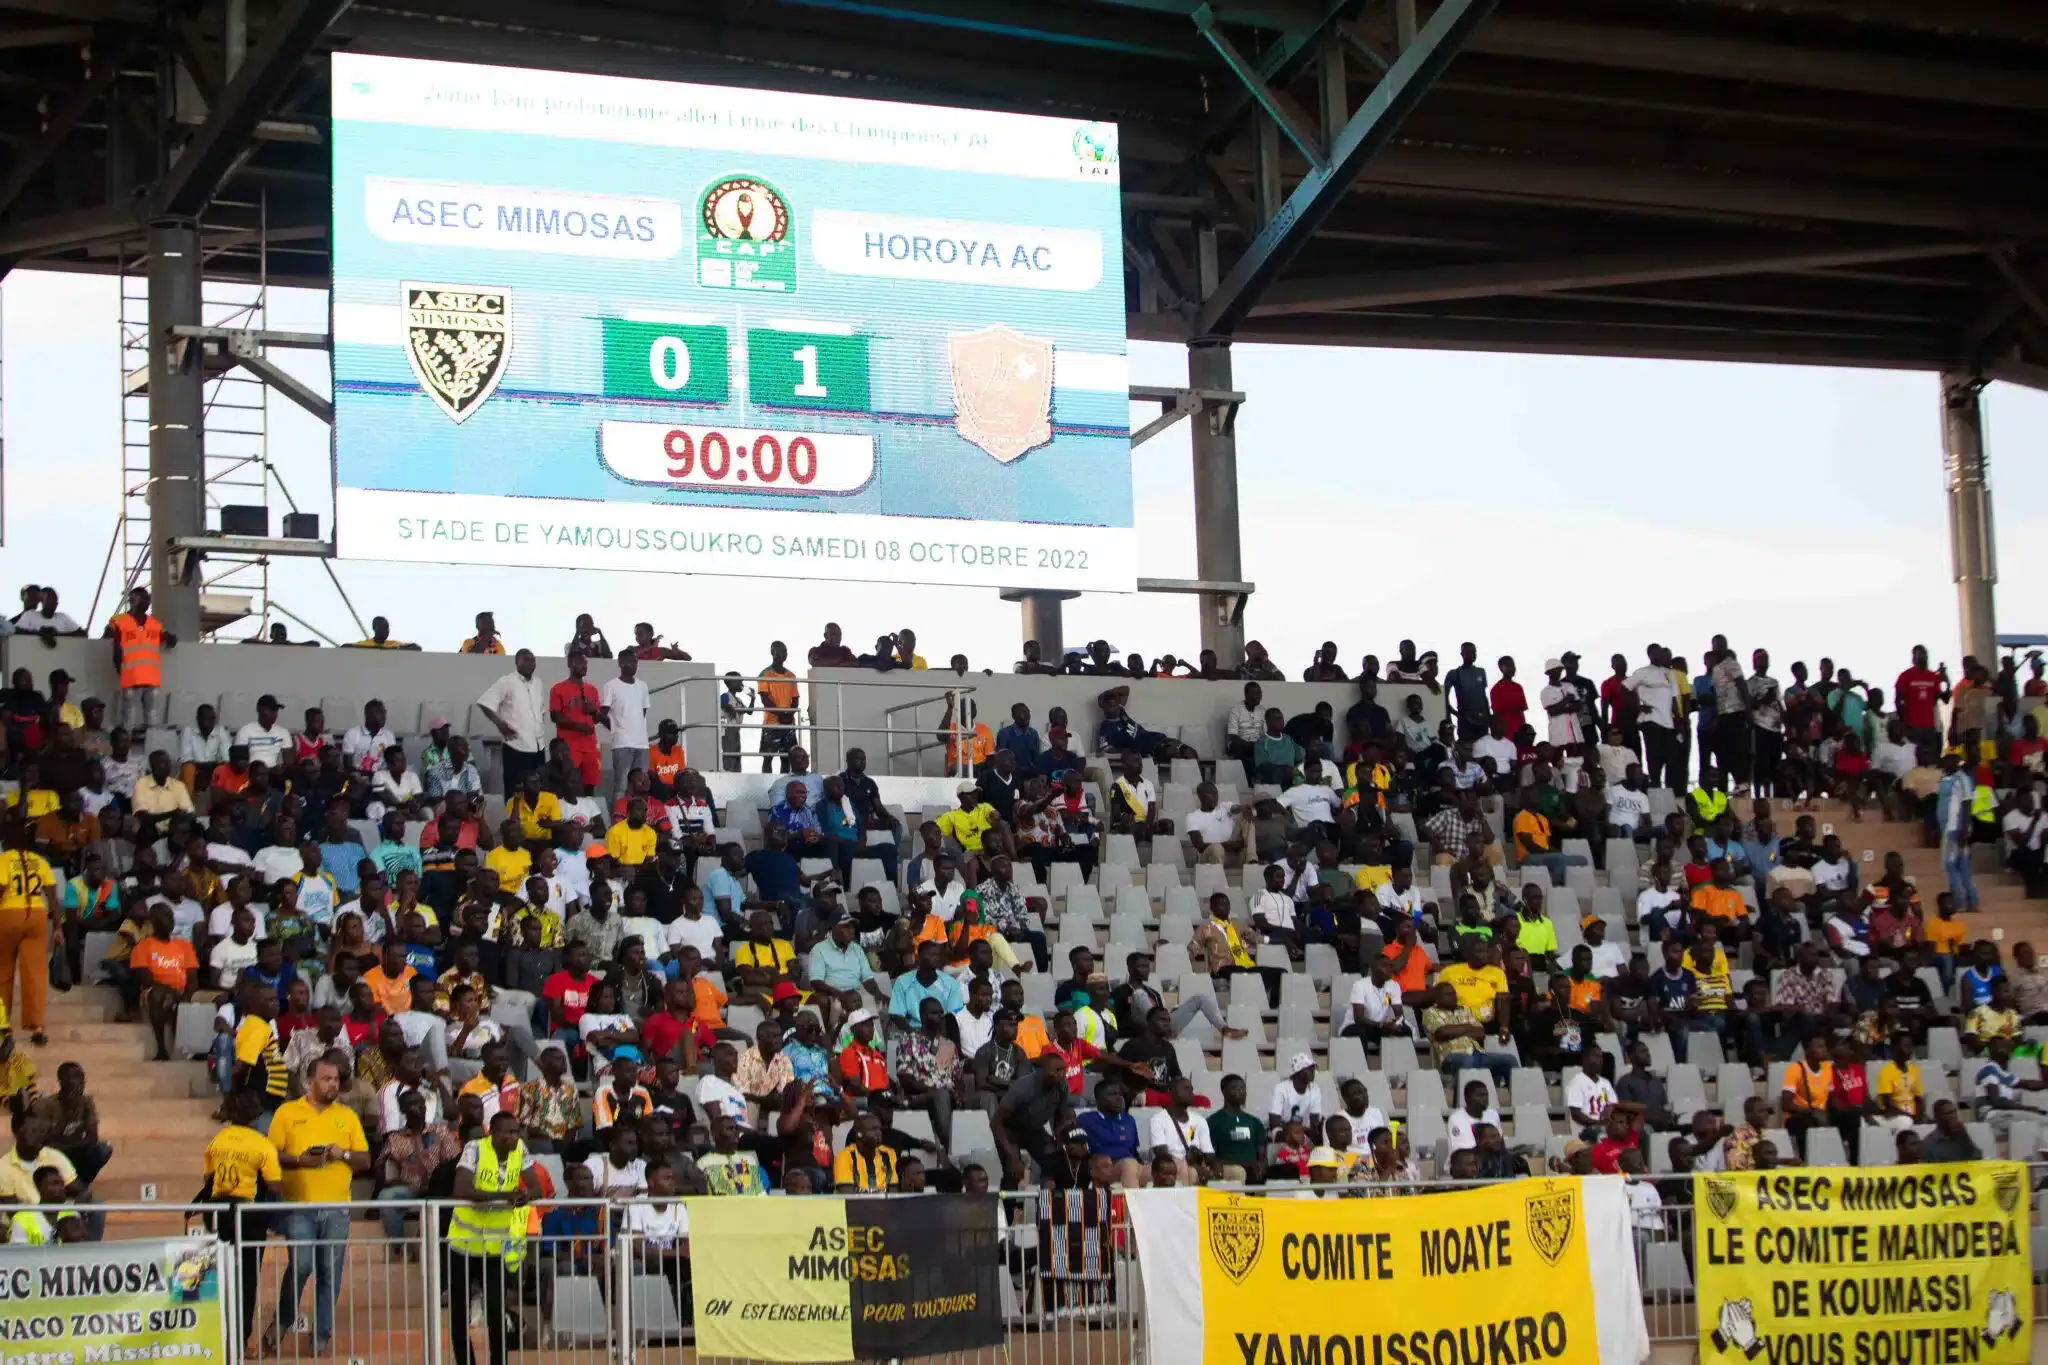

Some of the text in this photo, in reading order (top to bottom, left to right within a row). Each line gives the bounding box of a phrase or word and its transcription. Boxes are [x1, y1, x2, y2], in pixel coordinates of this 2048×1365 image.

[392, 198, 656, 242] ASEC MIMOSAS
[864, 231, 1053, 271] HOROYA AC
[410, 290, 503, 314] ASEC
[649, 336, 690, 391] 0
[793, 345, 827, 397] 1
[663, 429, 817, 485] 90:00
[398, 518, 1089, 570] STADE DE YAMOUSSOUKRO SAMEDI 08 OCTOBRE 2022
[1755, 1171, 1976, 1211] ASEC MIMOSAS
[808, 1225, 885, 1252] ASEC
[1281, 1219, 1513, 1281] COMITE MOAYE
[1707, 1219, 2021, 1265] LE COMITE MAINDEBA
[39, 1261, 166, 1298] MIMOSA
[788, 1253, 911, 1282] MIMOSAS
[705, 1298, 733, 1316] ON
[863, 1302, 906, 1321] POUR
[912, 1292, 978, 1320] TOUJOURS
[1773, 1274, 1971, 1318] DE KOUMASSI
[70, 1310, 142, 1337] ZONE
[149, 1307, 198, 1332] SUD
[1234, 1311, 1568, 1365] YAMOUSSOUKRO
[1763, 1326, 1982, 1365] VOUS SOUTIEN
